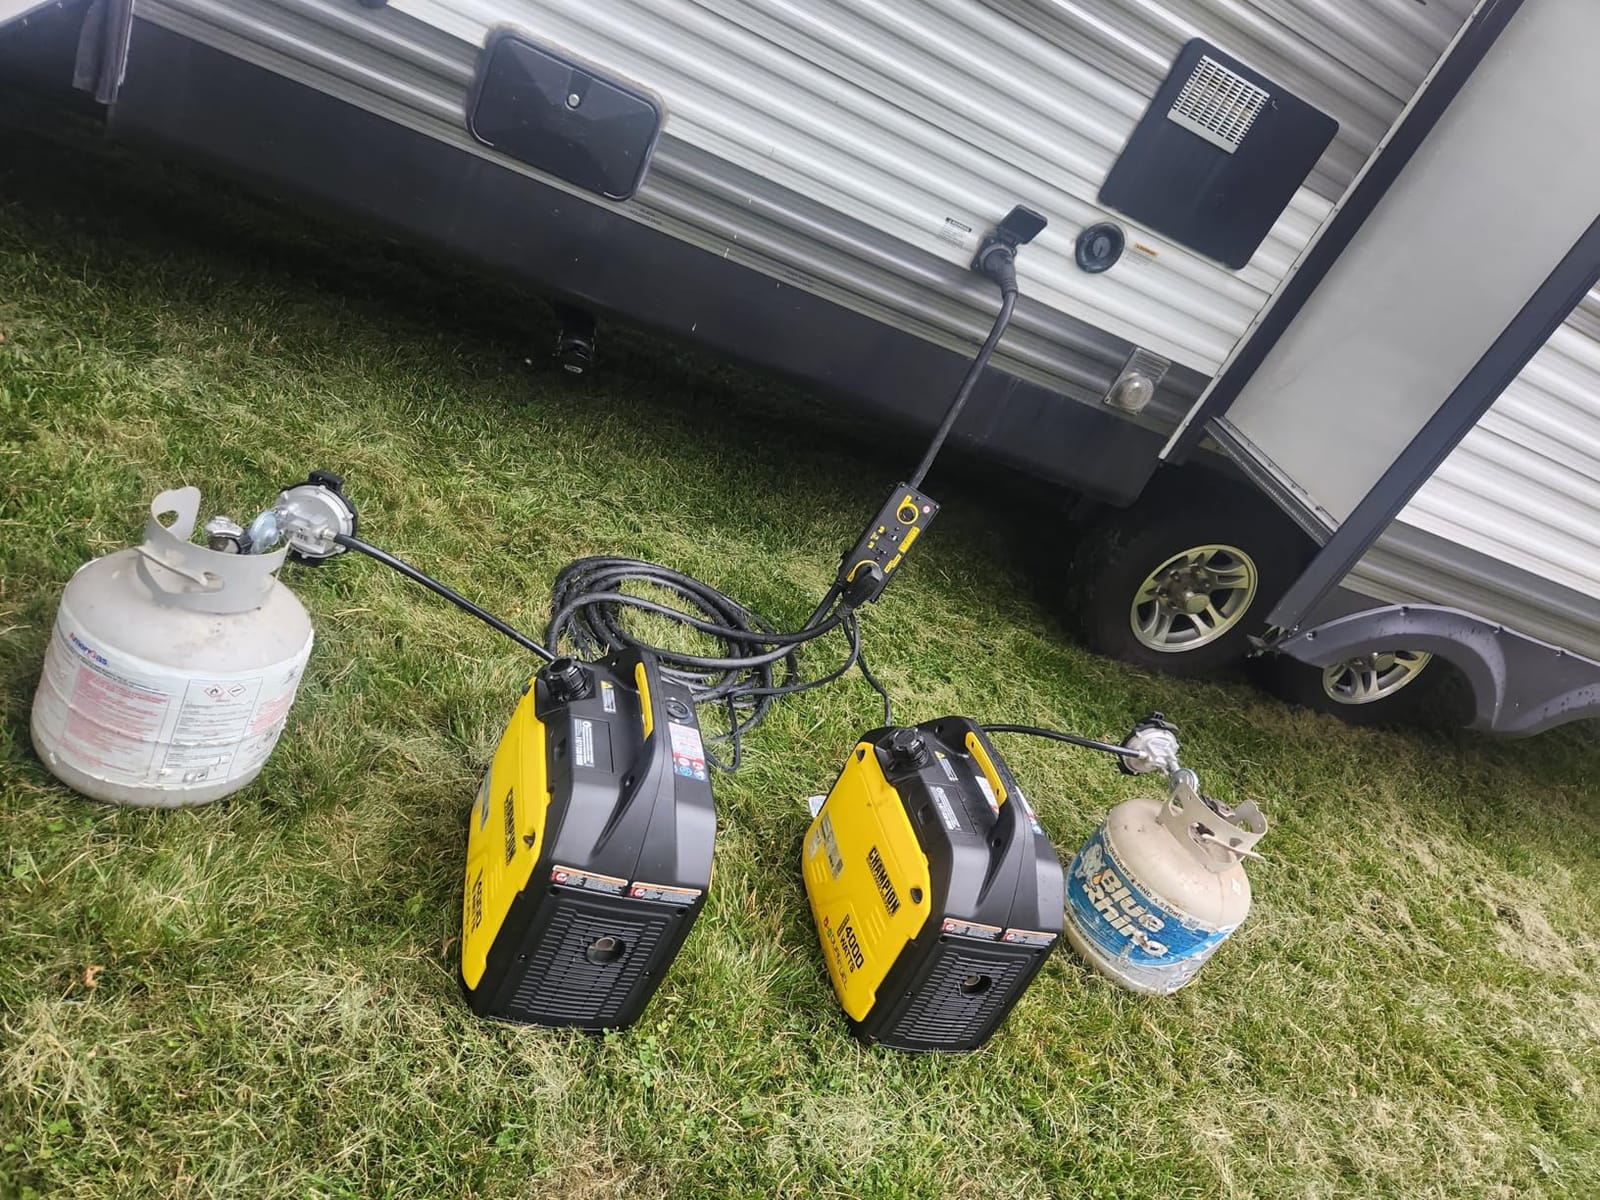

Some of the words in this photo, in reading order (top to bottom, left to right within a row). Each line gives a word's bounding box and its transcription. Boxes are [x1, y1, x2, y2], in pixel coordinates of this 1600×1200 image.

[868, 846, 901, 914] CHAMPION
[1101, 867, 1165, 933] Blue
[1109, 846, 1130, 876] DELIVERY
[1136, 882, 1153, 898] FIND
[845, 926, 865, 969] 4000
[1082, 882, 1169, 958] Rhino
[840, 934, 855, 973] WATTS
